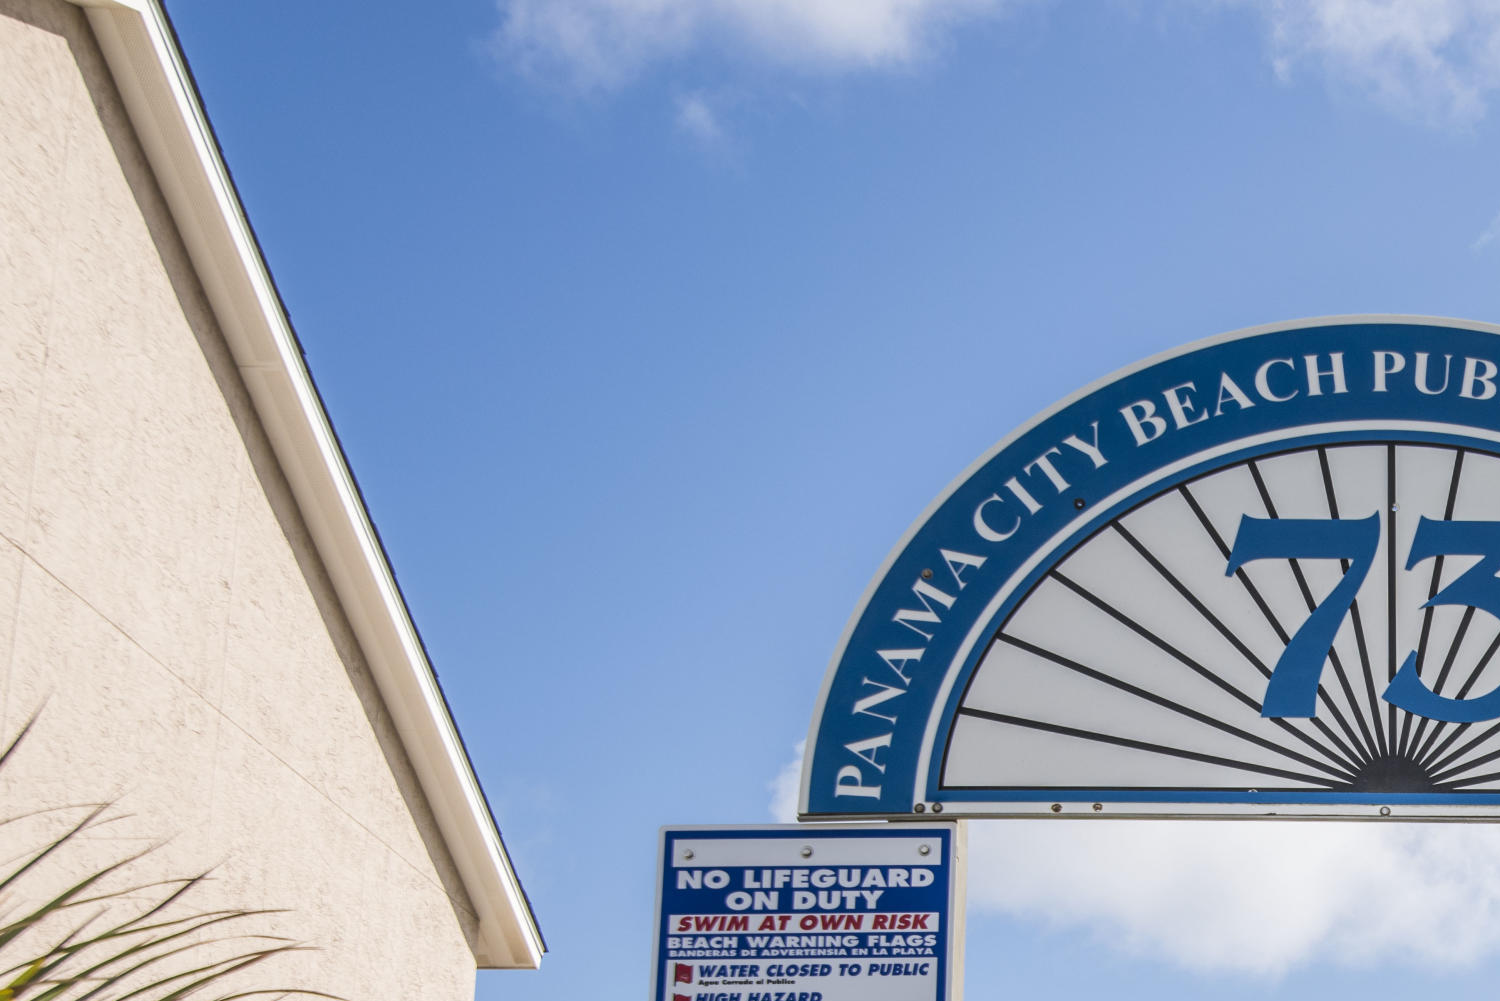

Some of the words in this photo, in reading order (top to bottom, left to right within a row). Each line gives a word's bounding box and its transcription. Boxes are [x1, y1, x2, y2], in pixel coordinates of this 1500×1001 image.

[834, 547, 989, 801] PANAMA
[972, 422, 1110, 544] CITY
[1118, 350, 1350, 448] BEACH
[676, 870, 730, 889] NO
[743, 868, 935, 889] LIFEGUARD
[725, 891, 779, 910] ON
[792, 890, 884, 910] DUTY
[676, 916, 752, 932] SWIM
[757, 915, 791, 931] AT
[797, 915, 864, 931] OWN
[870, 914, 930, 930] RISK
[665, 936, 739, 949] BEACH
[745, 935, 860, 949] WARNING
[866, 935, 937, 947] FLAGS
[668, 949, 737, 957] BANDERAS
[740, 949, 757, 957] DE
[760, 948, 847, 957] ADVERTENSIA
[850, 948, 868, 956] EN
[696, 964, 761, 978] WATER
[764, 964, 833, 977] CLOSED
[836, 963, 863, 977] TO
[866, 963, 930, 977] PUBLIC
